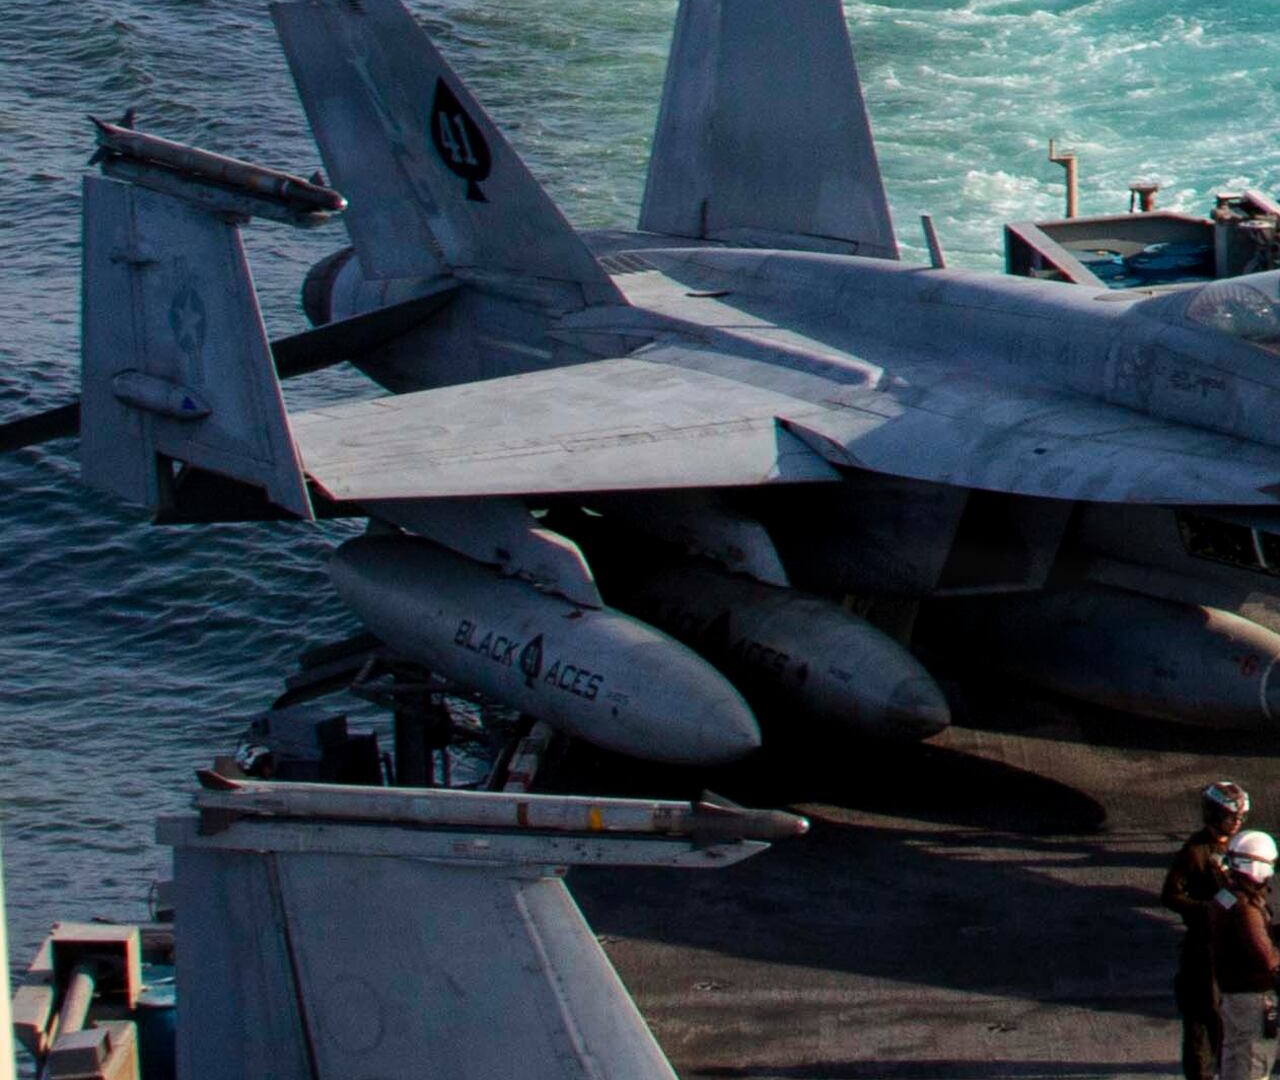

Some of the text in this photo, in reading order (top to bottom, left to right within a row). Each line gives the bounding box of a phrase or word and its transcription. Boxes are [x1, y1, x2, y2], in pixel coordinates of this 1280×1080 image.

[439, 111, 478, 165] 41
[454, 620, 520, 668] BLACK
[544, 660, 604, 701] ACES
